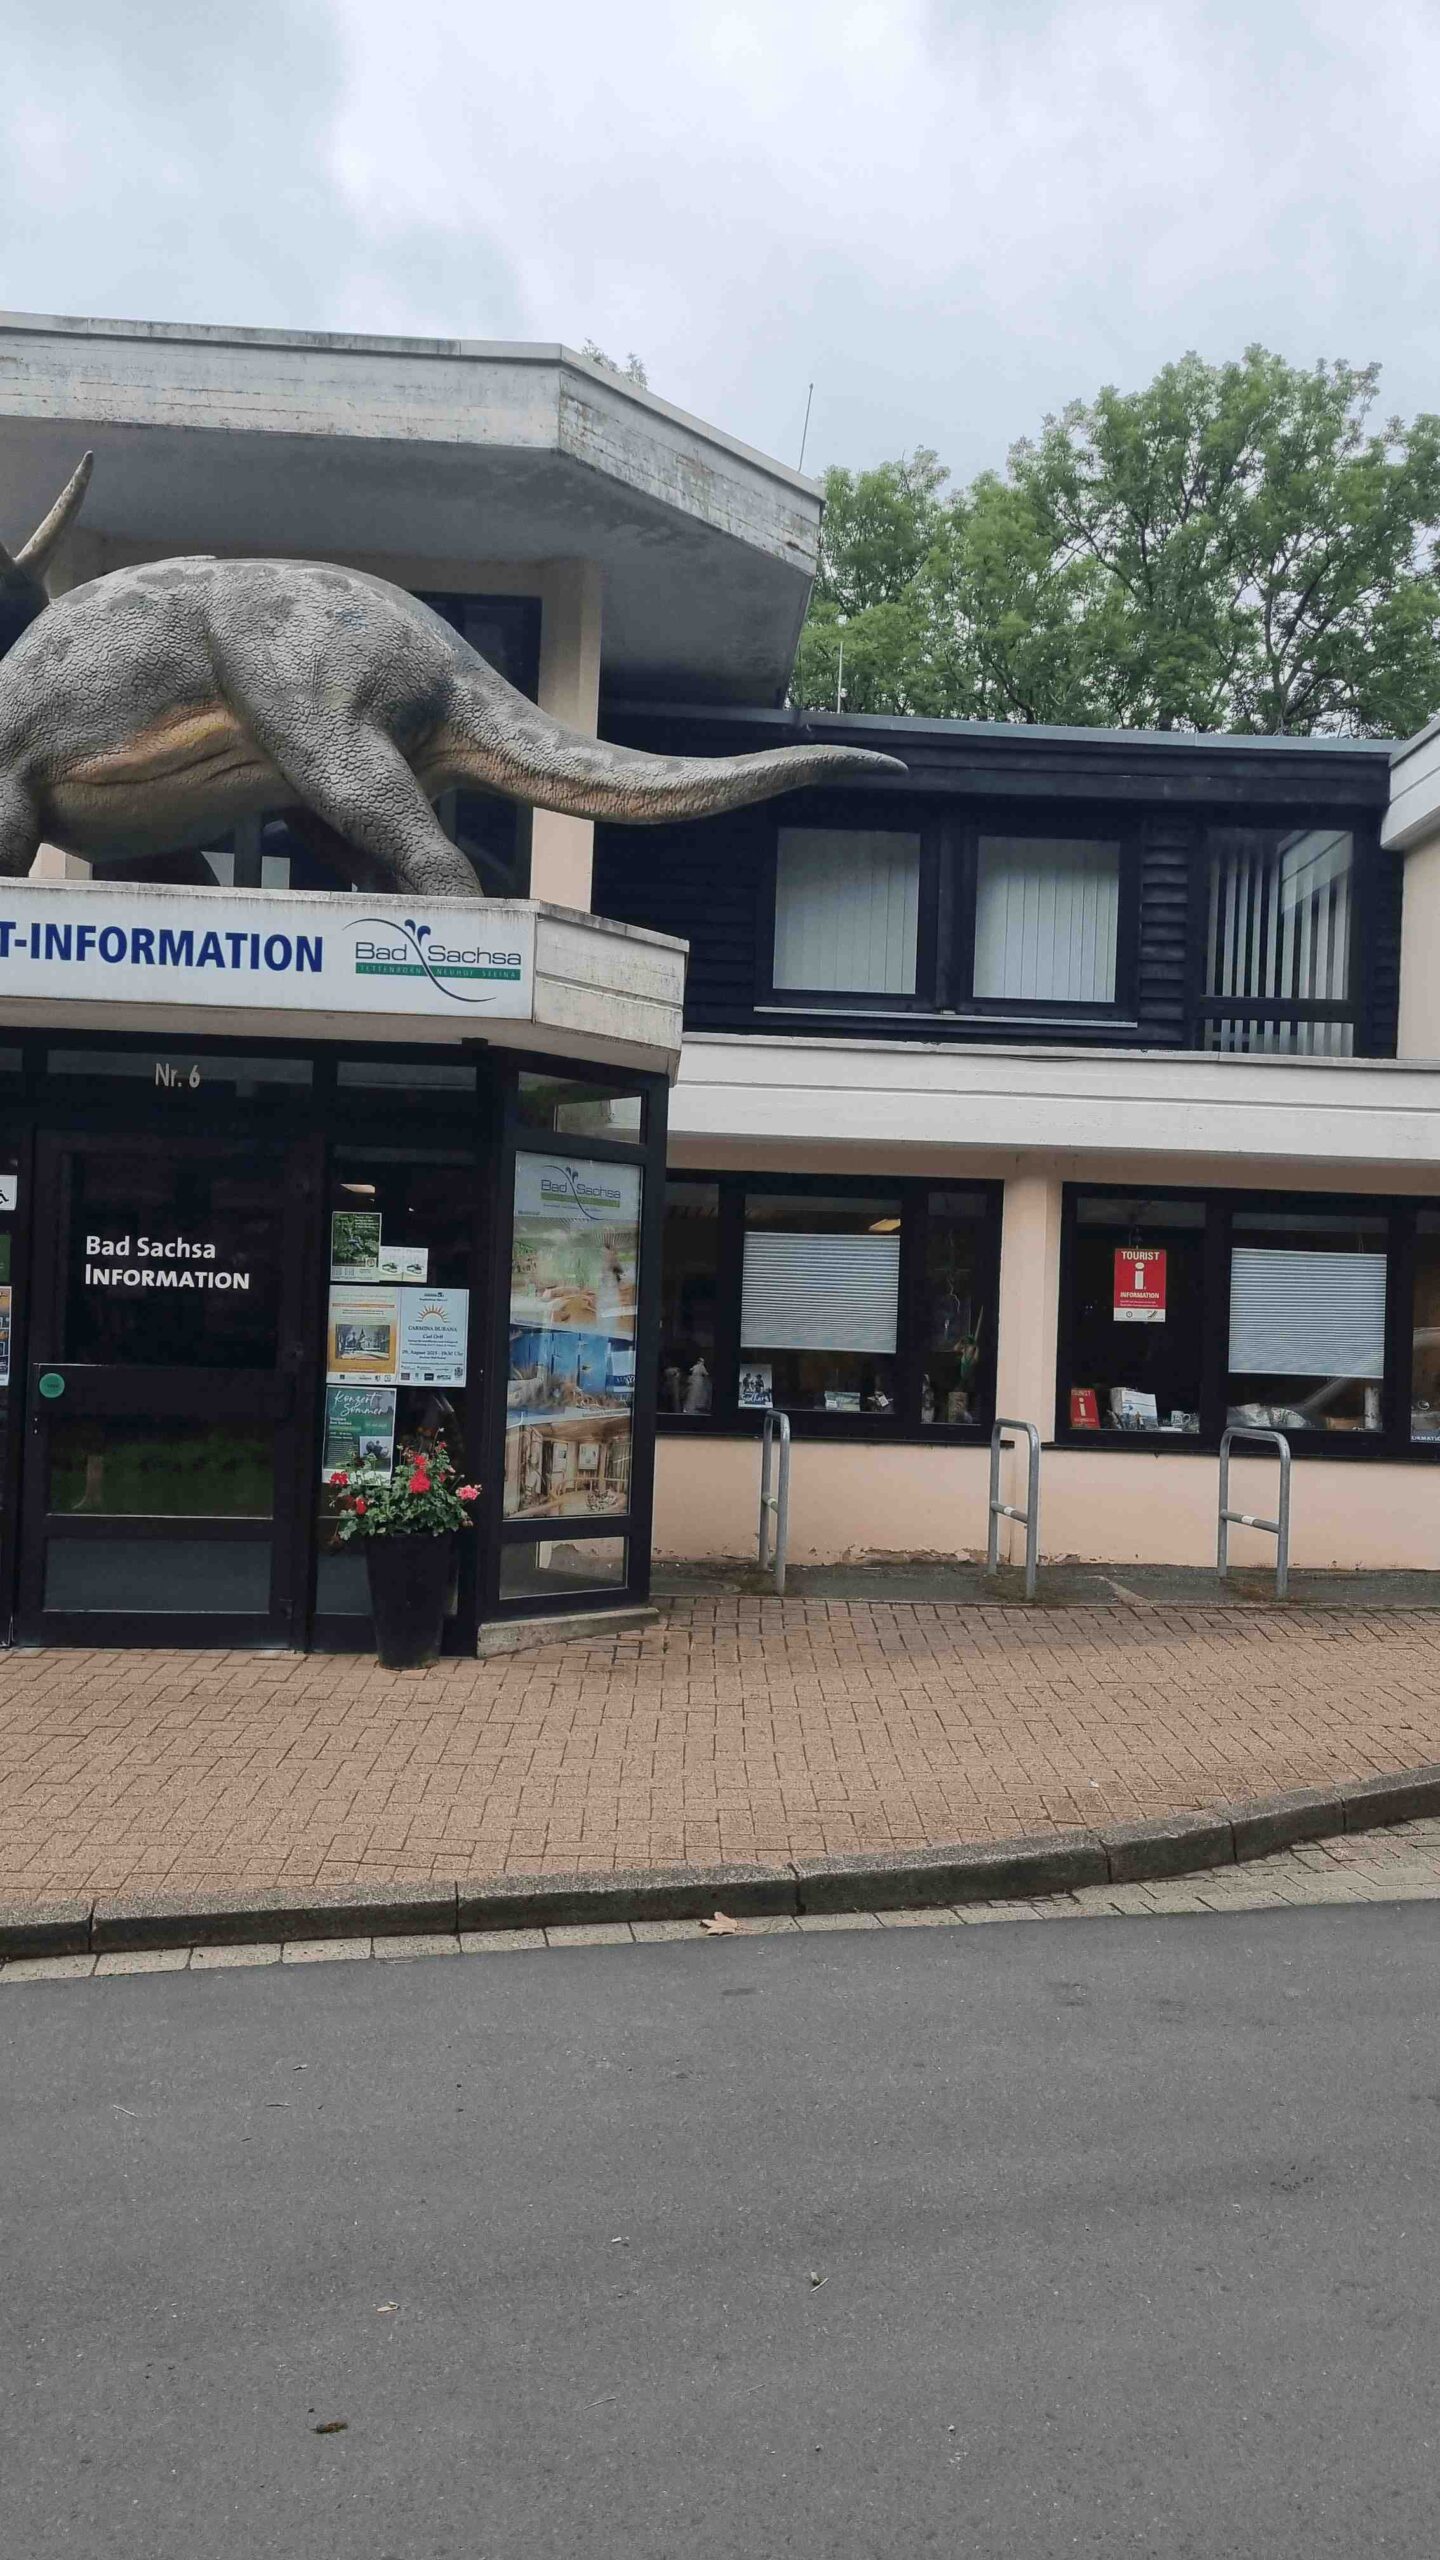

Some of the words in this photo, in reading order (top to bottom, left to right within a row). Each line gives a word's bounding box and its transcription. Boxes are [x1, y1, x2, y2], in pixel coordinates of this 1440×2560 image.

[355, 942, 407, 961] Bad
[427, 945, 521, 966] Sachsa
[154, 1063, 182, 1087] Nr.
[189, 1064, 200, 1088] 6
[541, 1179, 567, 1193] Bad
[576, 1183, 621, 1199] Sachsa
[86, 1236, 130, 1256] Bad
[137, 1237, 216, 1259] Sachsa
[1121, 1251, 1160, 1261] TOURIST
[1120, 1291, 1160, 1299] INFORMATION
